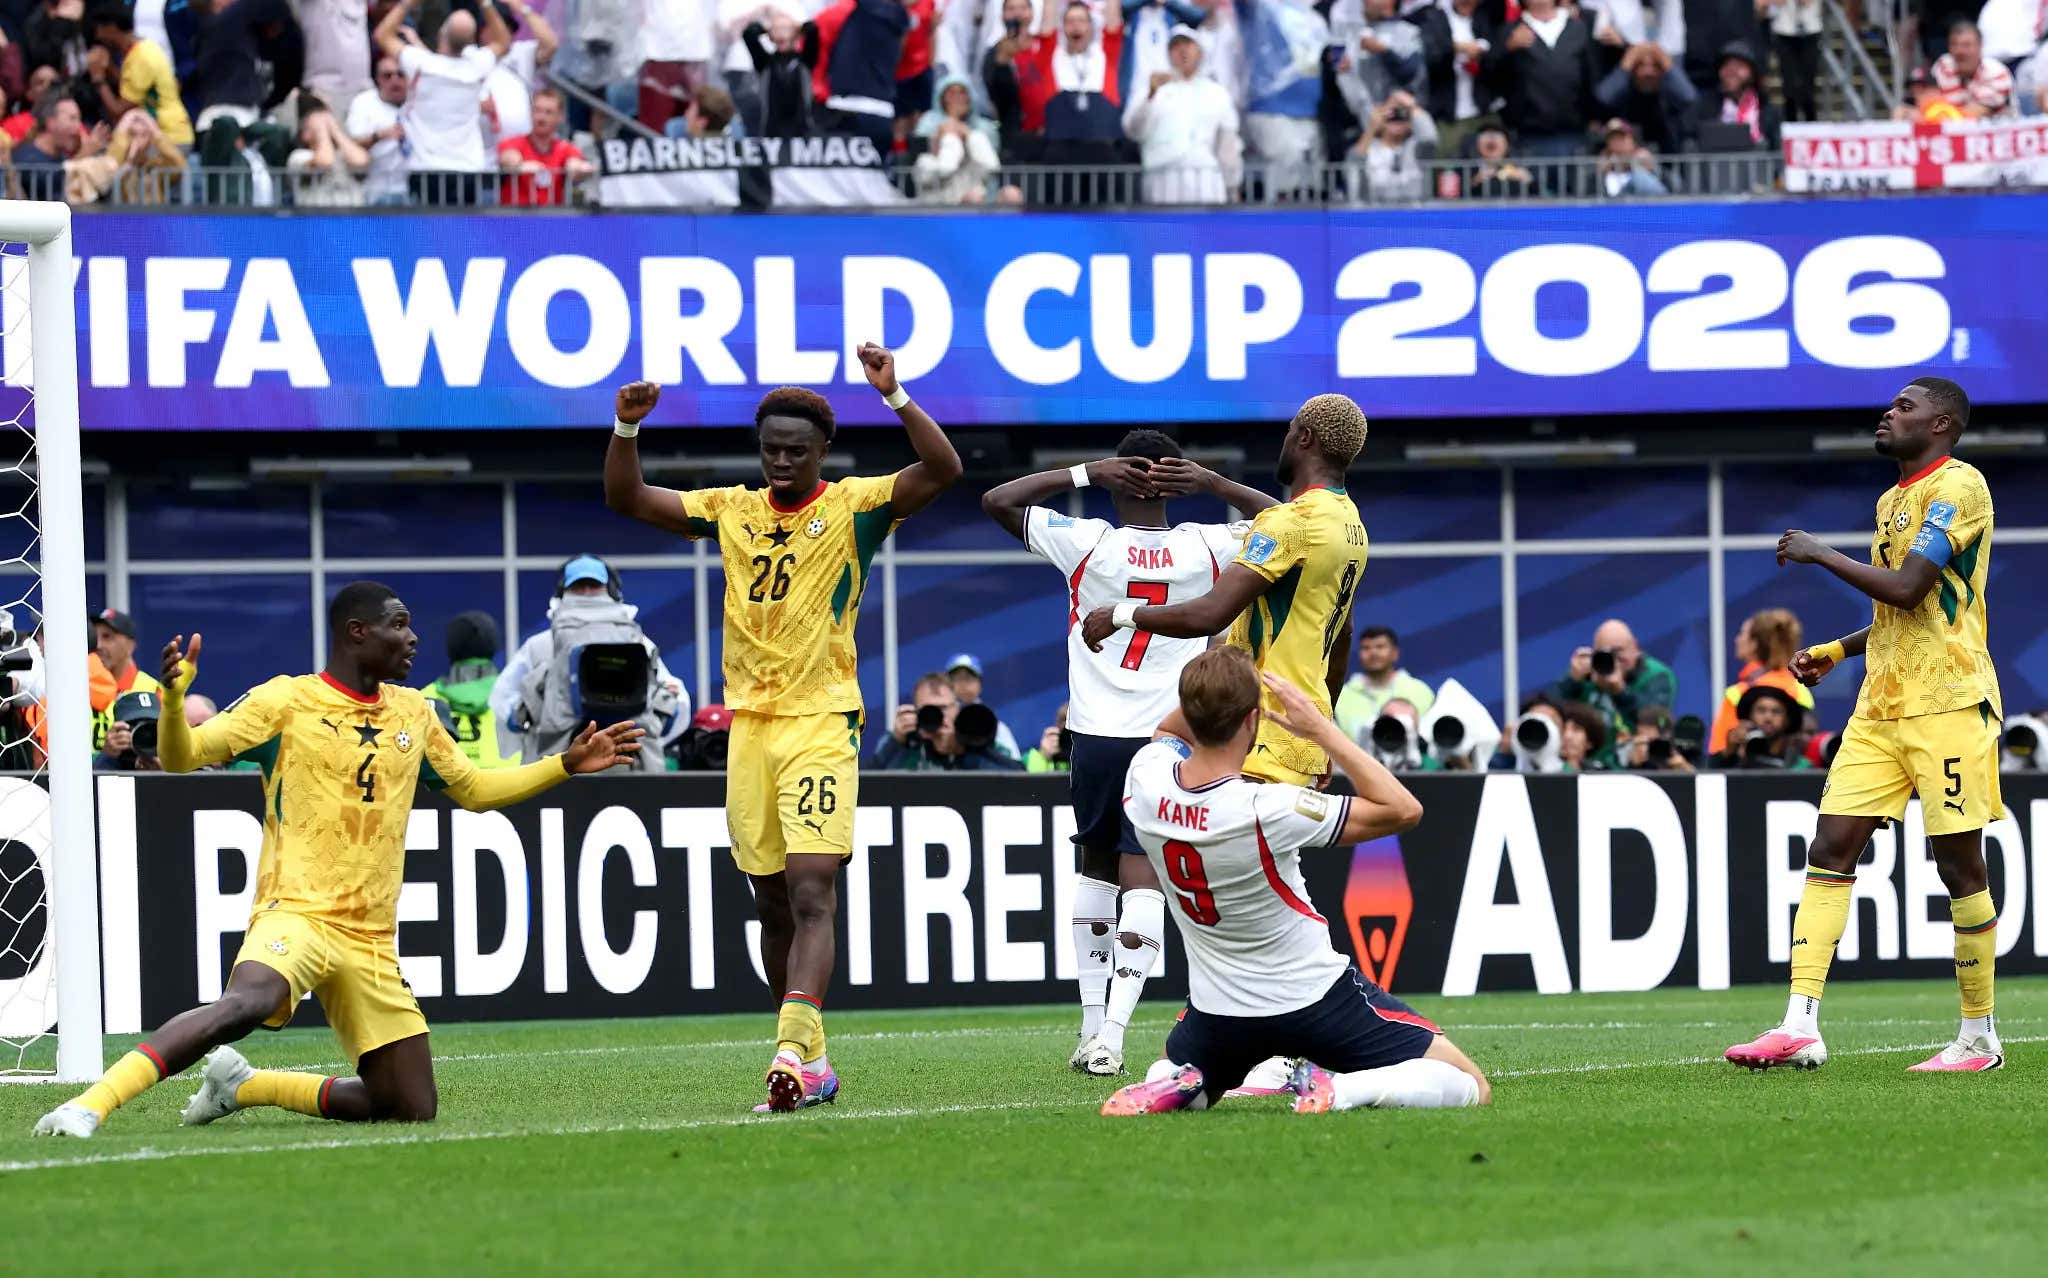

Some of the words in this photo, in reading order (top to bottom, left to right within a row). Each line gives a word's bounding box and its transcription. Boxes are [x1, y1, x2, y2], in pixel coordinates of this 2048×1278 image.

[604, 136, 782, 172] BARNSLEY
[790, 136, 882, 166] MAG
[1964, 128, 2048, 163] RED
[351, 253, 953, 389] WORLD
[984, 252, 1304, 385] CUP
[1335, 235, 1951, 378] 2026
[1345, 523, 1364, 547] SIBO
[1127, 545, 1174, 569] SAKA
[749, 553, 796, 603] 26
[1120, 581, 1169, 671] 7
[356, 753, 376, 802] 4
[797, 775, 837, 815] 26
[1944, 758, 1961, 797] 5
[1157, 796, 1210, 832] KANE
[1162, 839, 1222, 927] 9
[1441, 772, 1730, 997] ADI
[1953, 958, 1979, 968] HANA
